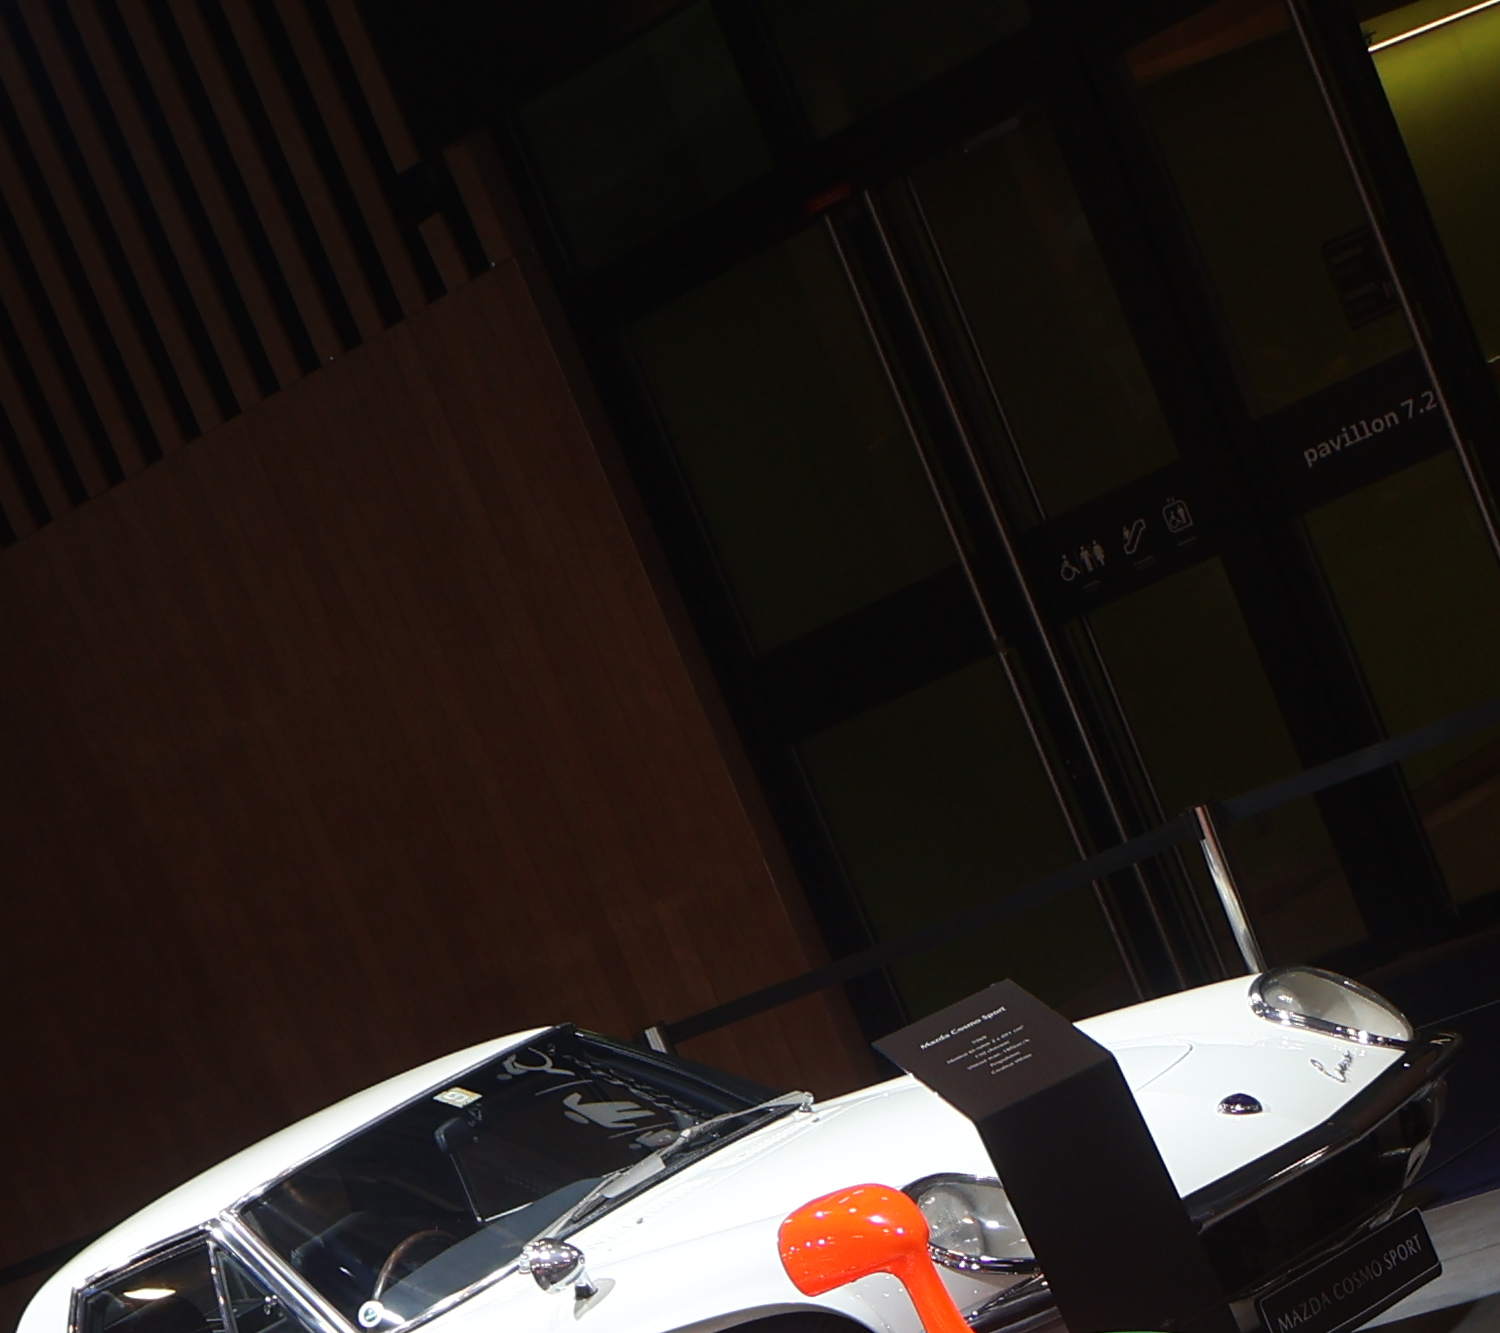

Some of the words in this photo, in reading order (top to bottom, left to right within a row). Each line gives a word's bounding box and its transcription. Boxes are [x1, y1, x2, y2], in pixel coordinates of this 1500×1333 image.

[1303, 413, 1400, 467] pavillon
[1333, 1260, 1383, 1301] COSMO
[1383, 1234, 1423, 1271] SPORT
